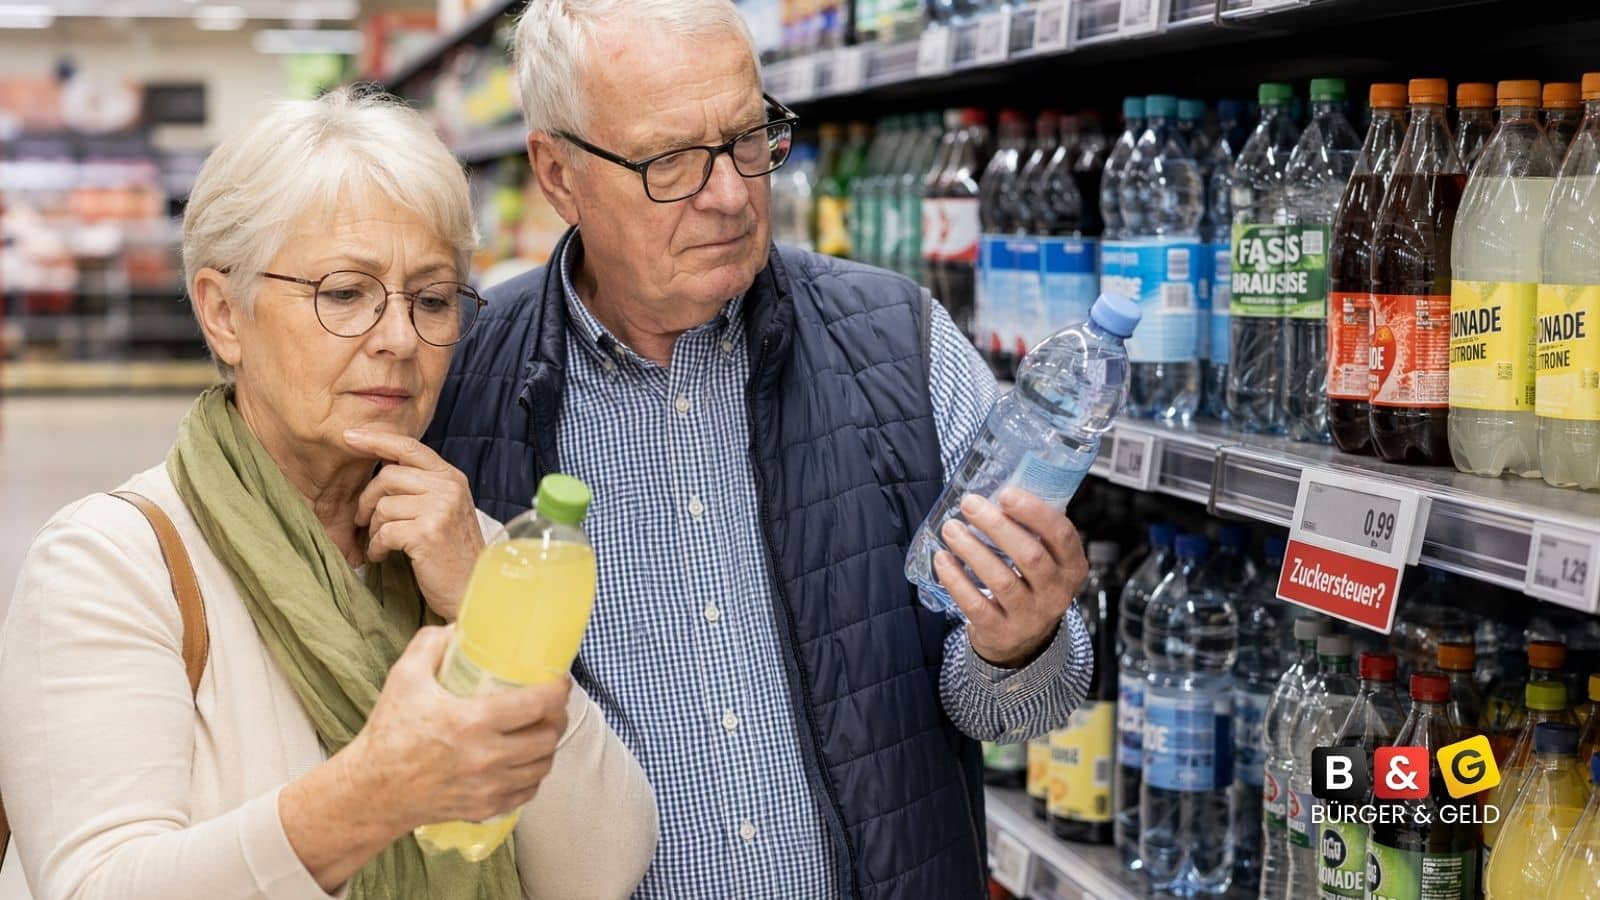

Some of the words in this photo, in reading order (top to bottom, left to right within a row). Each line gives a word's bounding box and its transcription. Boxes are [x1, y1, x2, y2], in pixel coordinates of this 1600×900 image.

[1451, 306, 1502, 338] ONADE
[1364, 509, 1395, 540] 0.99
[1289, 557, 1386, 609] Zuckersteuer?
[1319, 865, 1364, 890] ONADE
